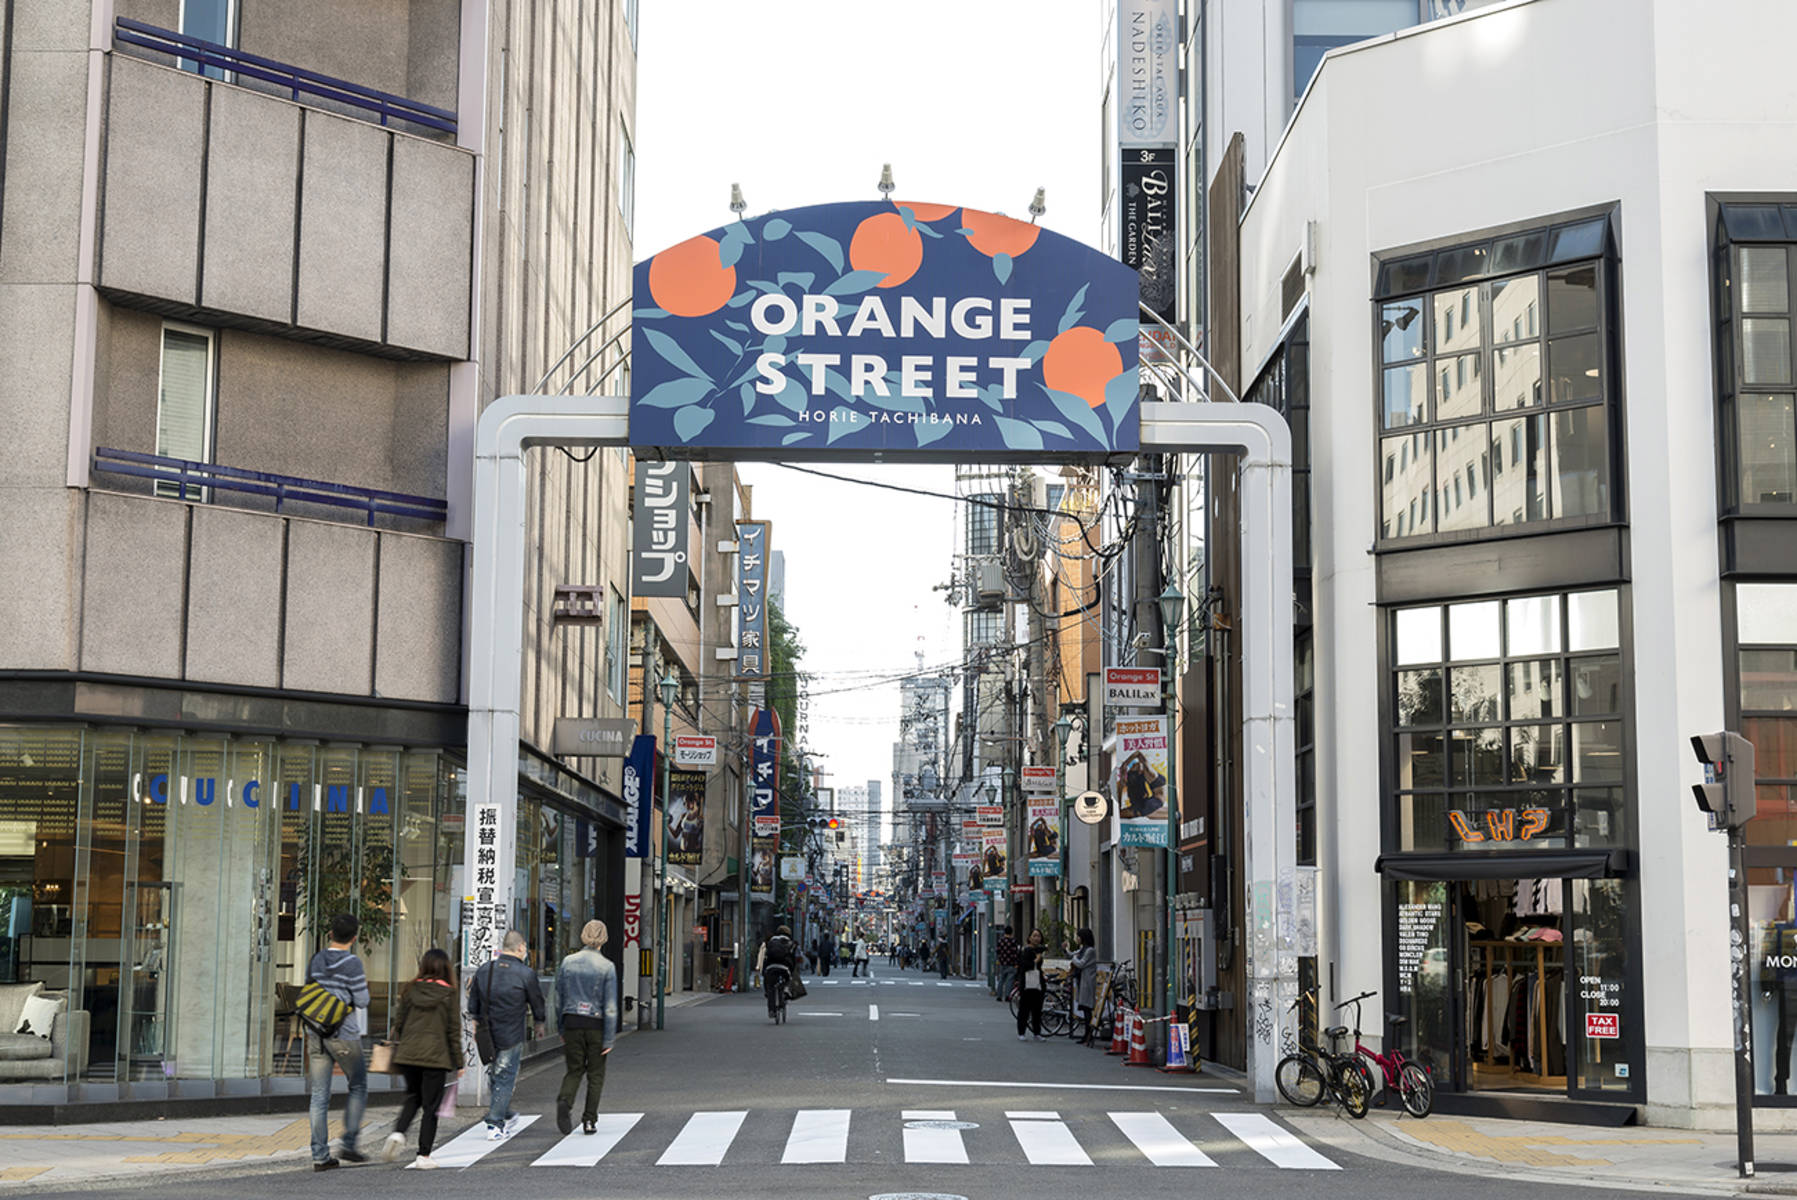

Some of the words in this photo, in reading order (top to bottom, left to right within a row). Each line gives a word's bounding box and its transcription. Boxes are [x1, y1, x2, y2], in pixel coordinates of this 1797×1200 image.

[1131, 12, 1146, 131] NADESHIKO
[1140, 150, 1156, 162] 3F
[1128, 202, 1137, 220] THE
[1128, 222, 1137, 265] GARDEN
[750, 294, 1032, 340] ORANGE
[755, 353, 1032, 399] STREET
[799, 410, 858, 423] HORIE
[869, 411, 982, 425] TACHIBANA
[742, 527, 762, 675] イチマツ家具
[1109, 672, 1144, 682] Orange
[799, 677, 809, 752] JOURNA
[579, 730, 624, 743] CUCINA
[150, 773, 389, 815] CUCINA
[1449, 807, 1551, 842] LHP
[1580, 976, 1601, 984] OPEN
[1588, 1026, 1617, 1035] FREE
[1591, 1017, 1612, 1025] TAX
